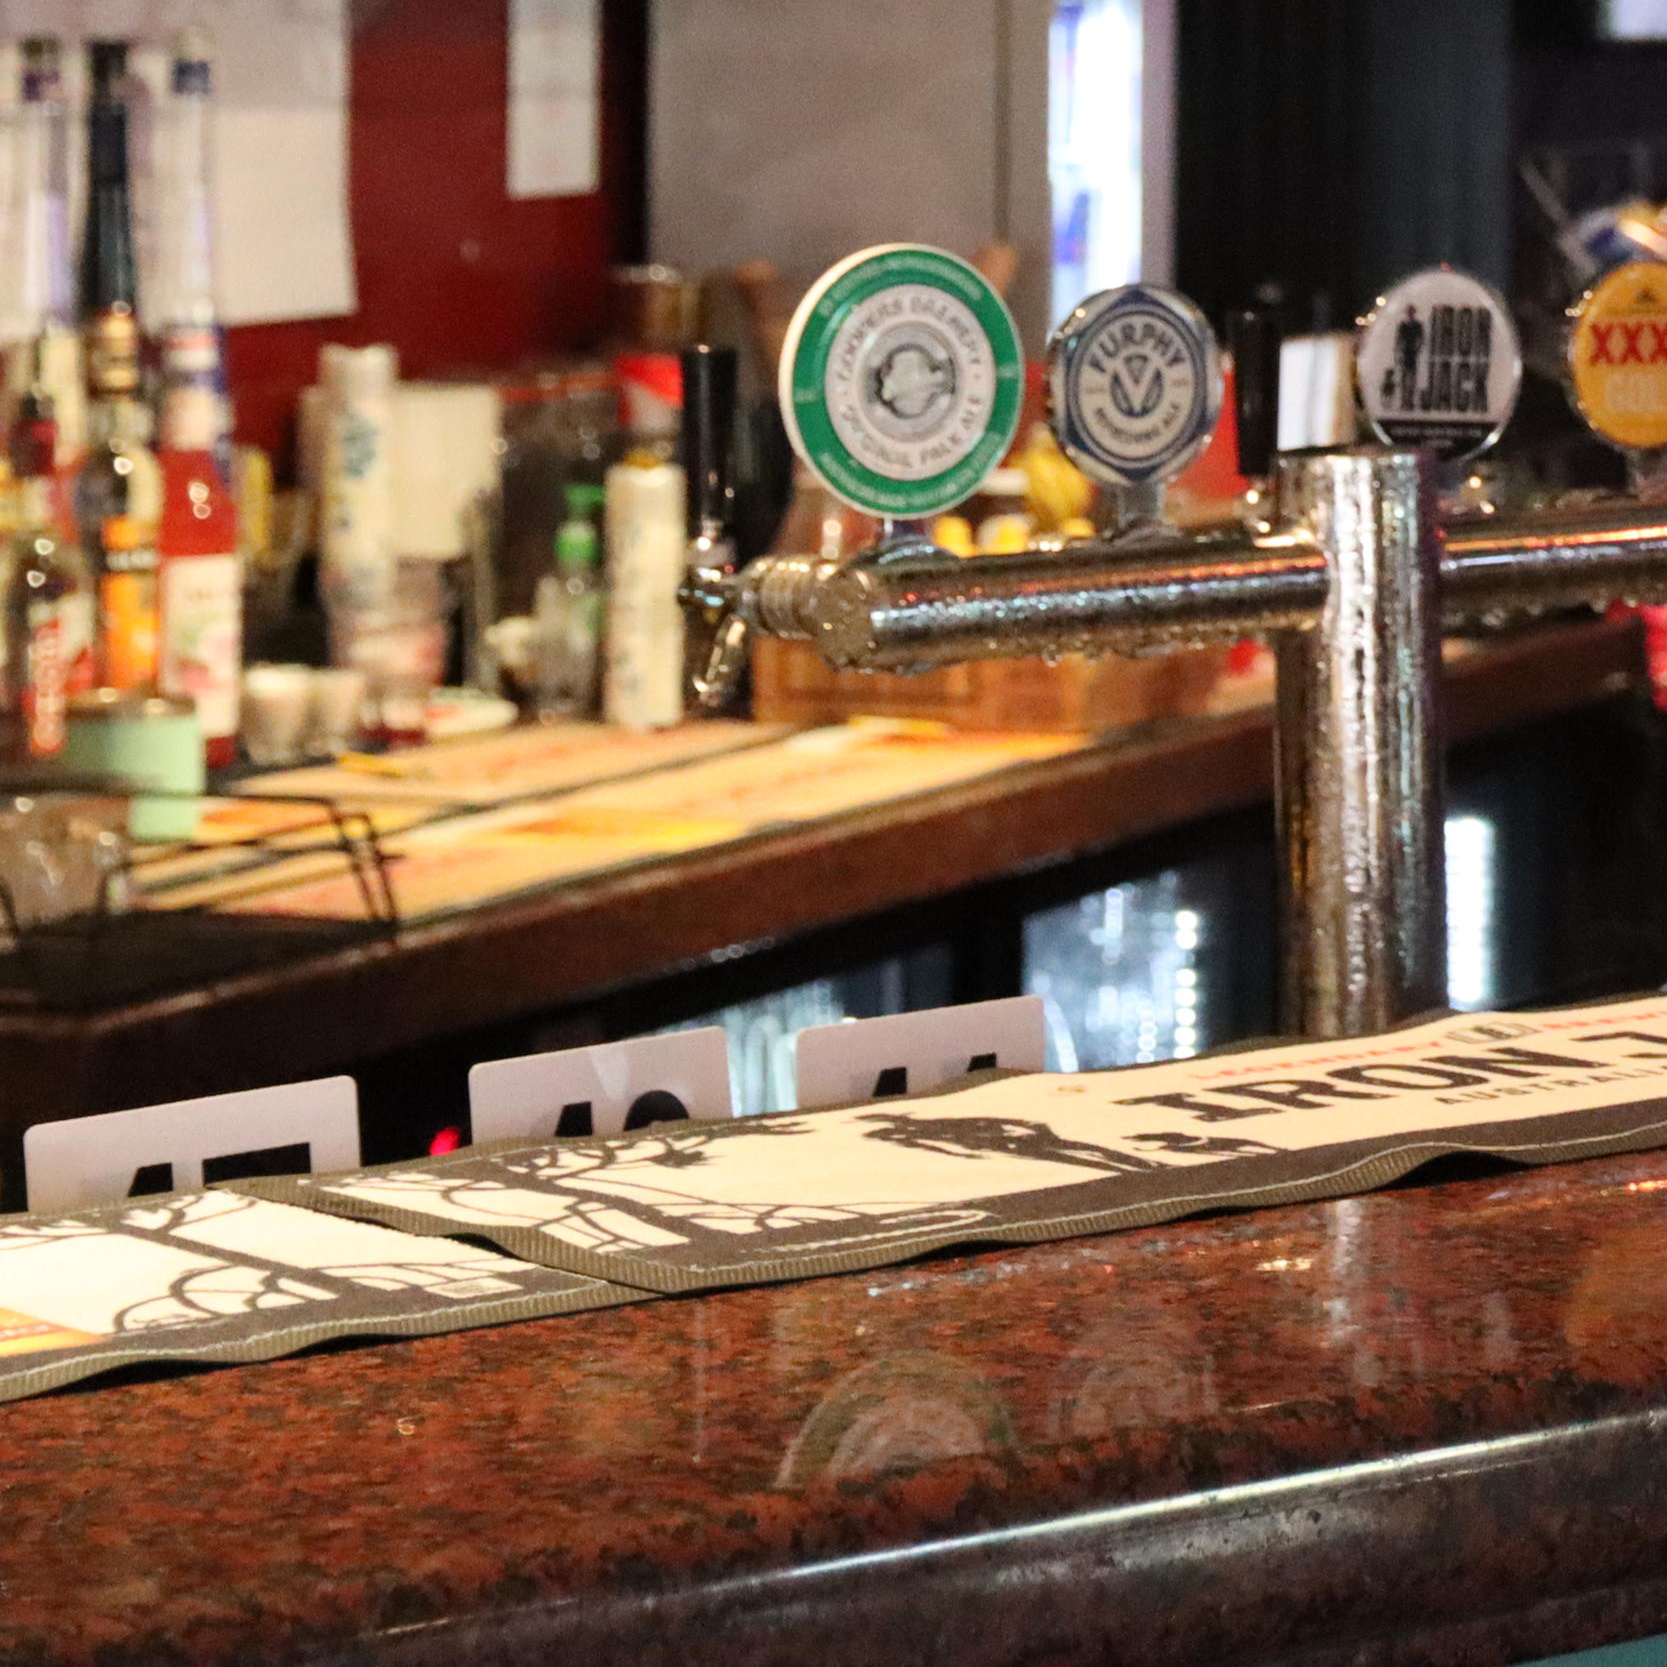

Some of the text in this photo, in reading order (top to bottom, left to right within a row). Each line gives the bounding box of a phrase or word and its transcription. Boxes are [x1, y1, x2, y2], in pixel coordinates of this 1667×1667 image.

[1089, 321, 1186, 374] FURPHY
[1428, 304, 1492, 359] IRON
[1420, 360, 1489, 414] JACK
[1112, 1046, 1616, 1123] IRON
